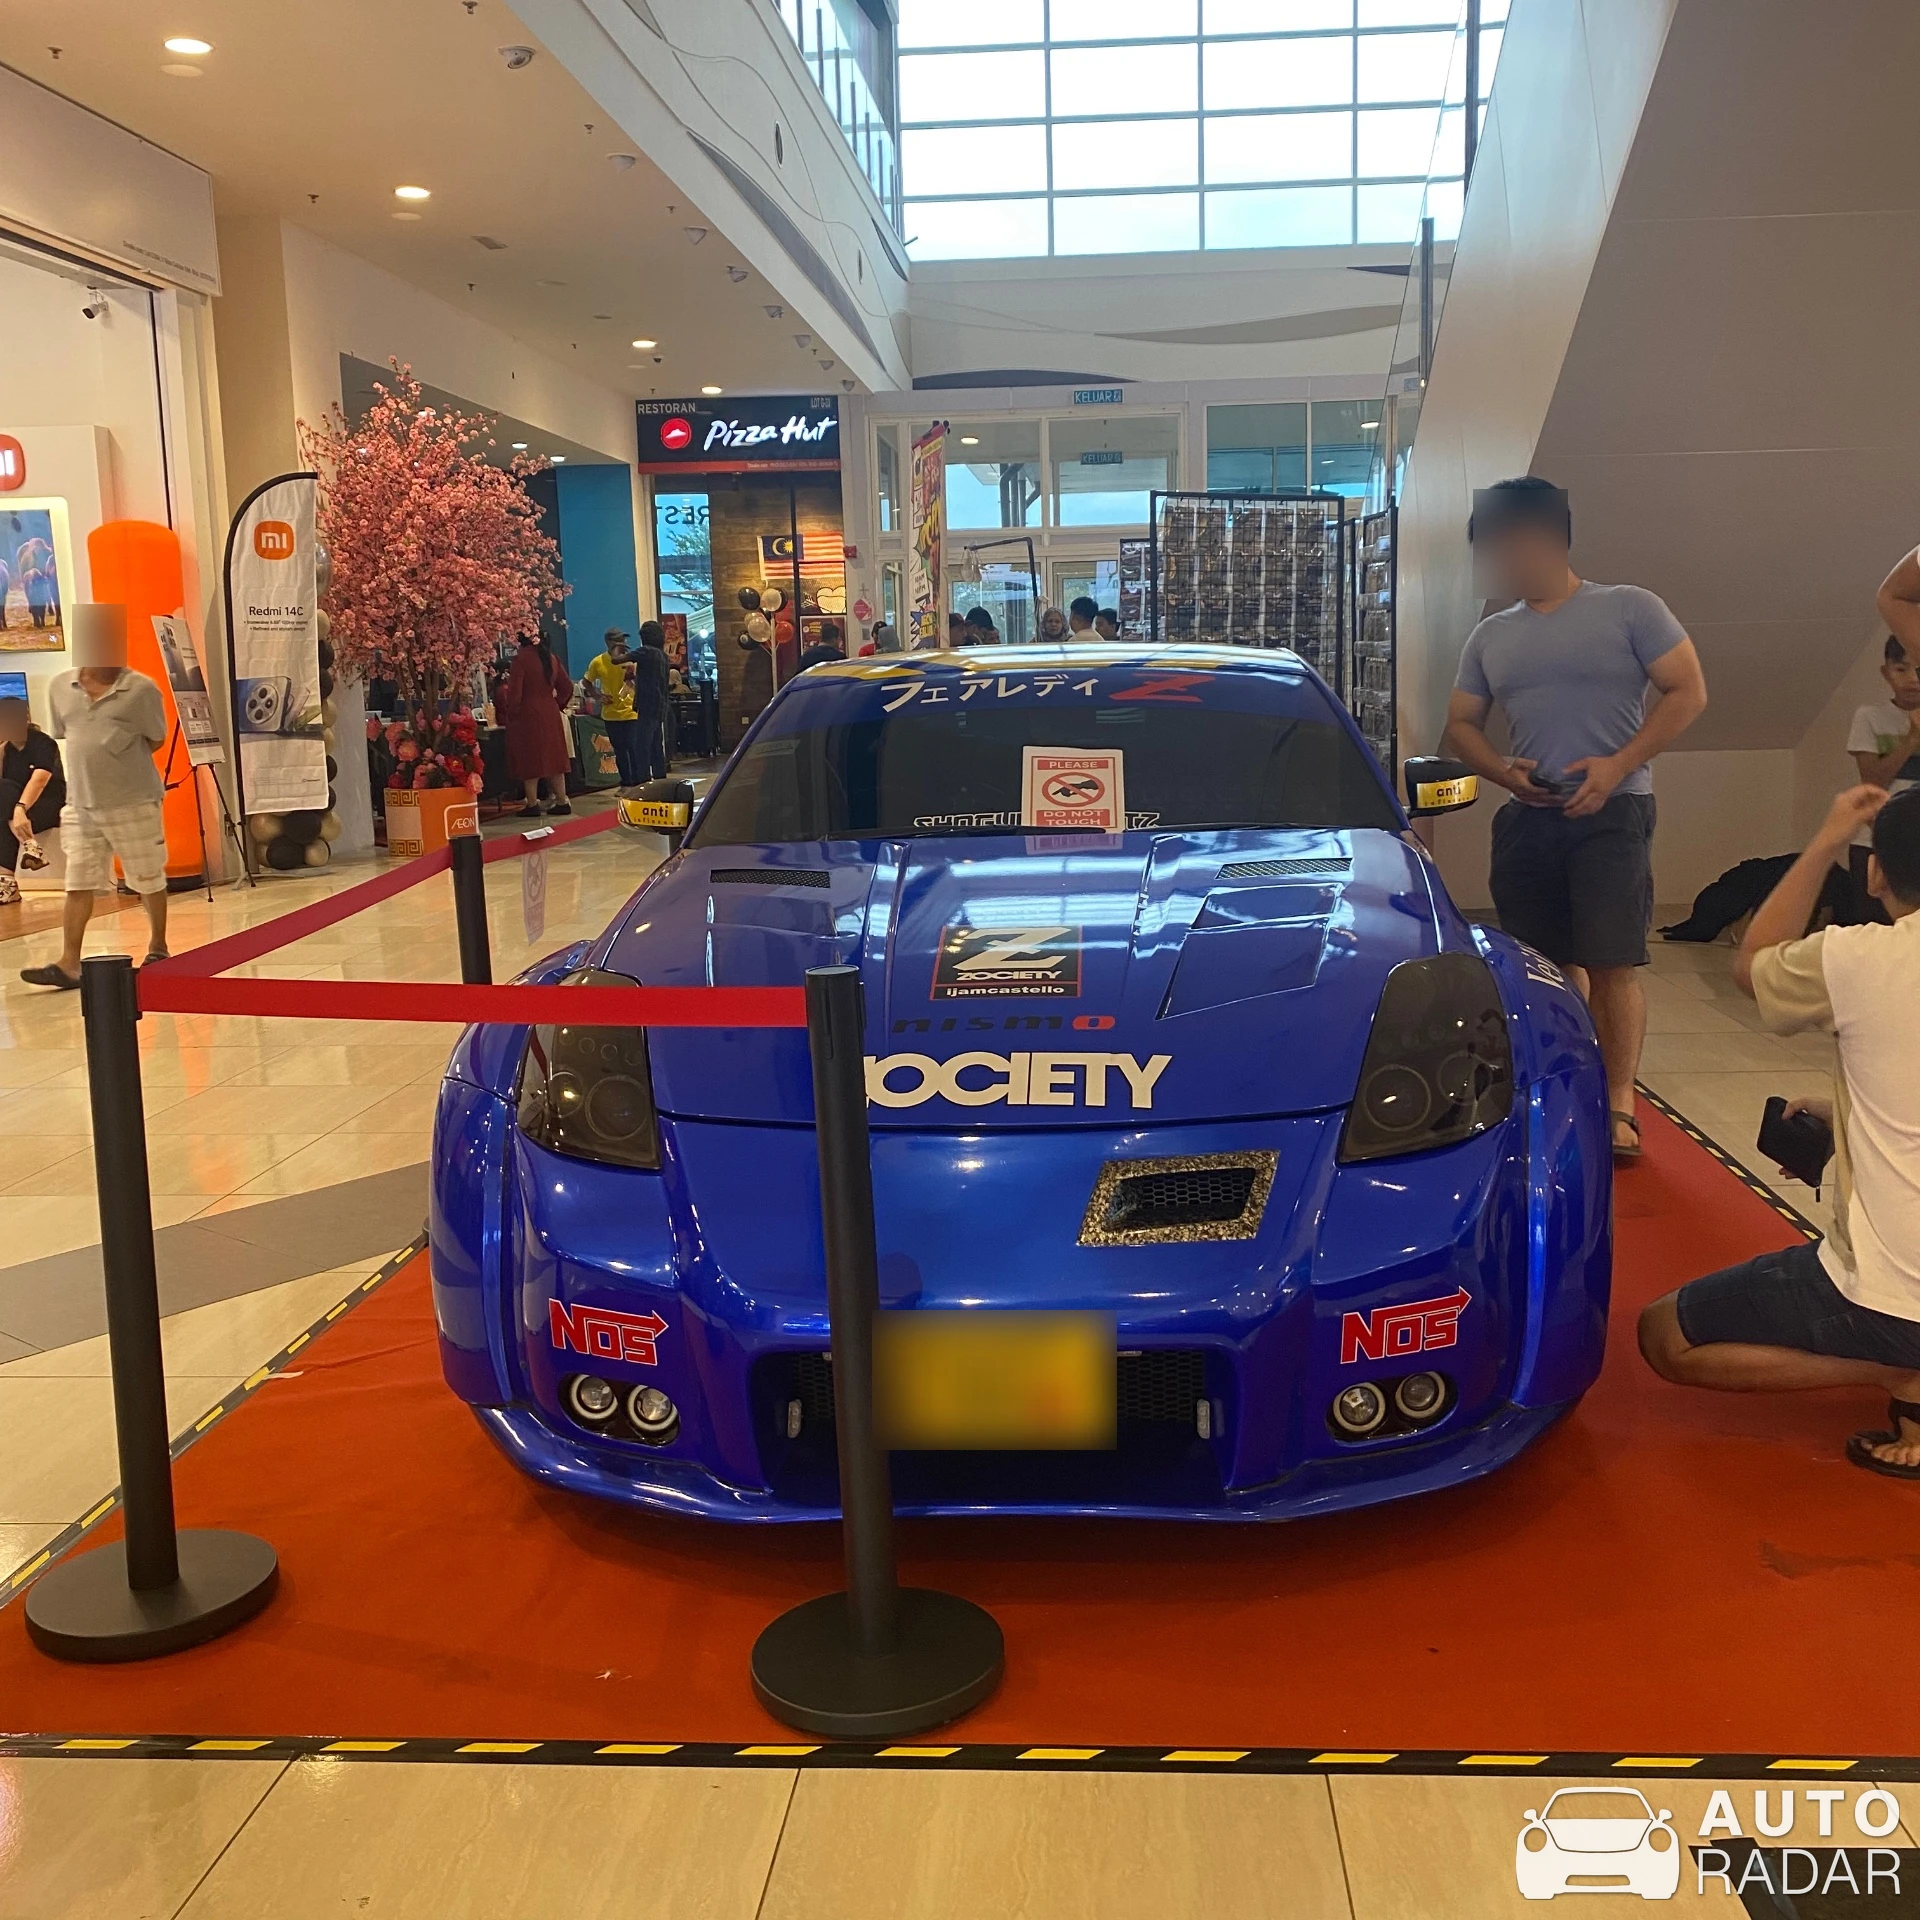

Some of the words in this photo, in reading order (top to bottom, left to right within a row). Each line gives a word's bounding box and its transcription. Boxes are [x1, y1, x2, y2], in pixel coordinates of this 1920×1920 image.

[1075, 389, 1112, 403] KELUAR
[637, 403, 697, 414] RESTORAN
[703, 420, 778, 451] Pizza
[780, 415, 838, 444] Hut
[1083, 453, 1113, 463] KELUAR
[249, 606, 282, 616] Redmi
[285, 606, 304, 616] 14C
[1108, 672, 1216, 703] Z
[1049, 761, 1098, 769] PLEASE
[1437, 782, 1461, 796] anti
[642, 805, 669, 817] anti
[1071, 810, 1104, 818] NOT
[1046, 818, 1101, 826] TOUCH
[956, 970, 1062, 981] ZOCIETY
[946, 986, 1065, 996] ijamcastello
[892, 1014, 1116, 1034] nismo
[863, 1051, 1173, 1109] OCIETY
[1340, 1285, 1472, 1365] NOS
[548, 1297, 669, 1366] NOS
